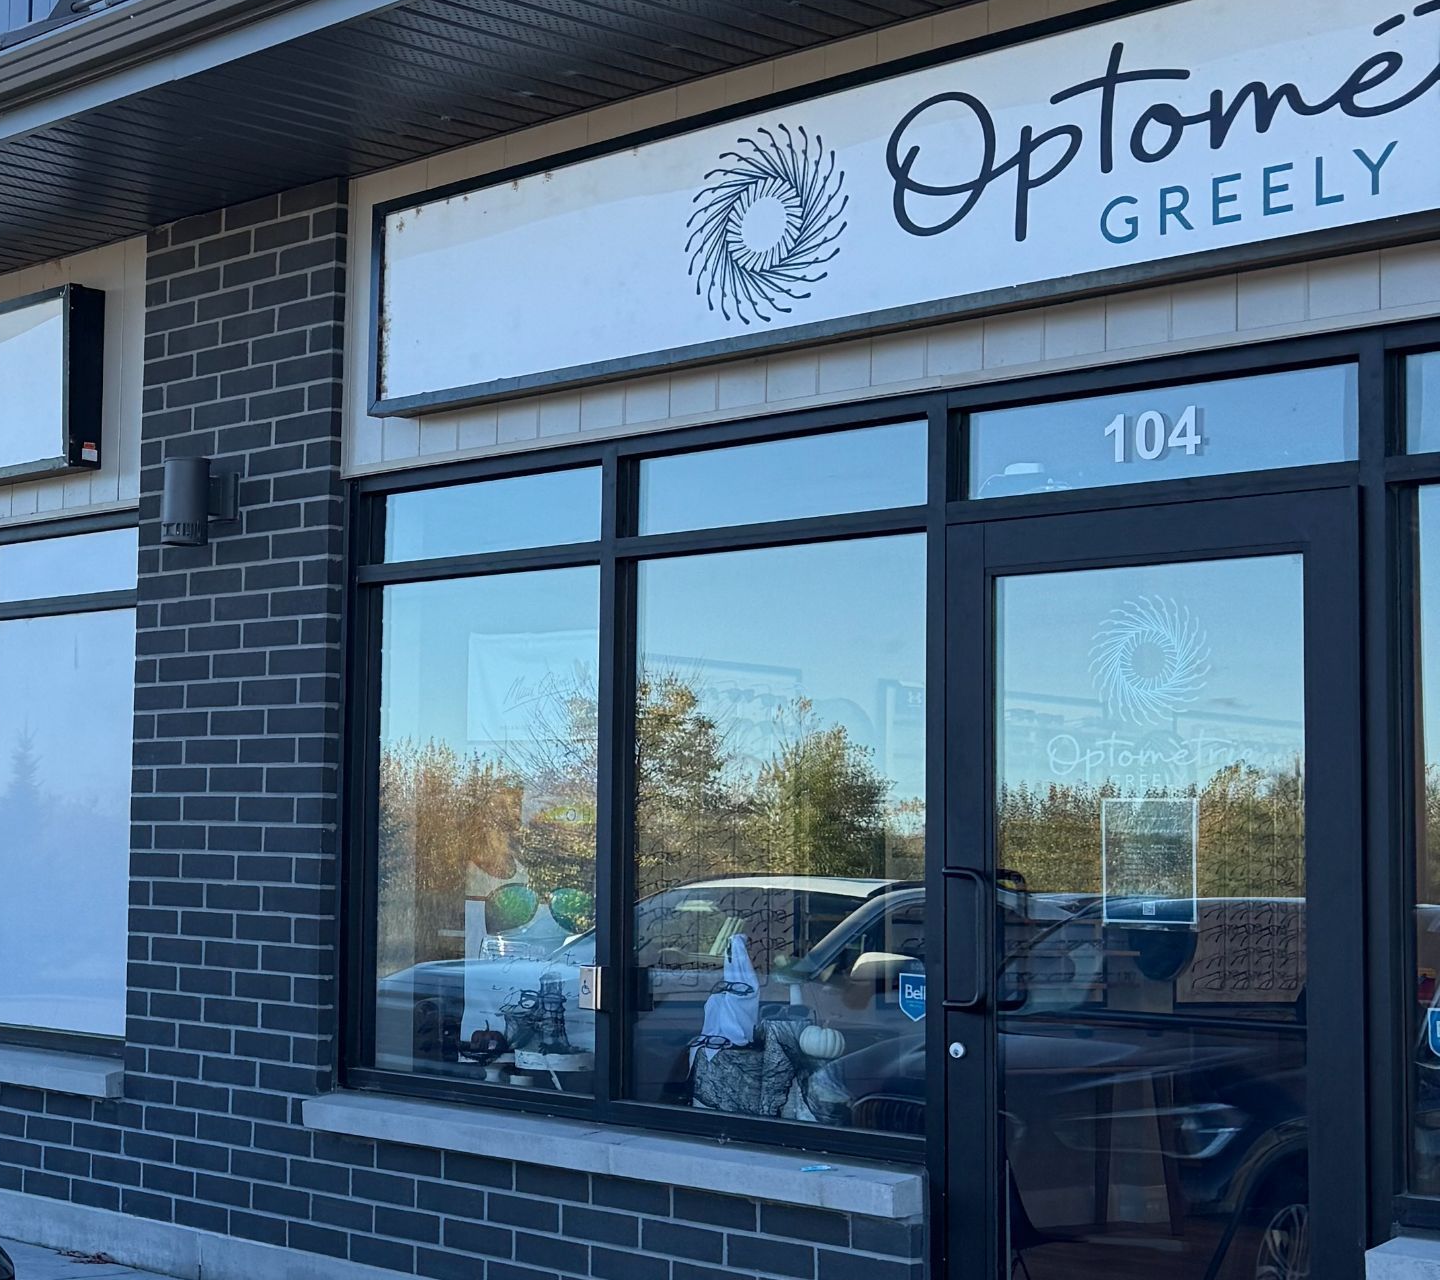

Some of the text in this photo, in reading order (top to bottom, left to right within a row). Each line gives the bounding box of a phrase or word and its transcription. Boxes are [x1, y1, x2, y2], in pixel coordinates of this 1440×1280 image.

[1100, 140, 1399, 244] GREELY
[1104, 405, 1202, 463] 104
[904, 983, 927, 1001] Bell
